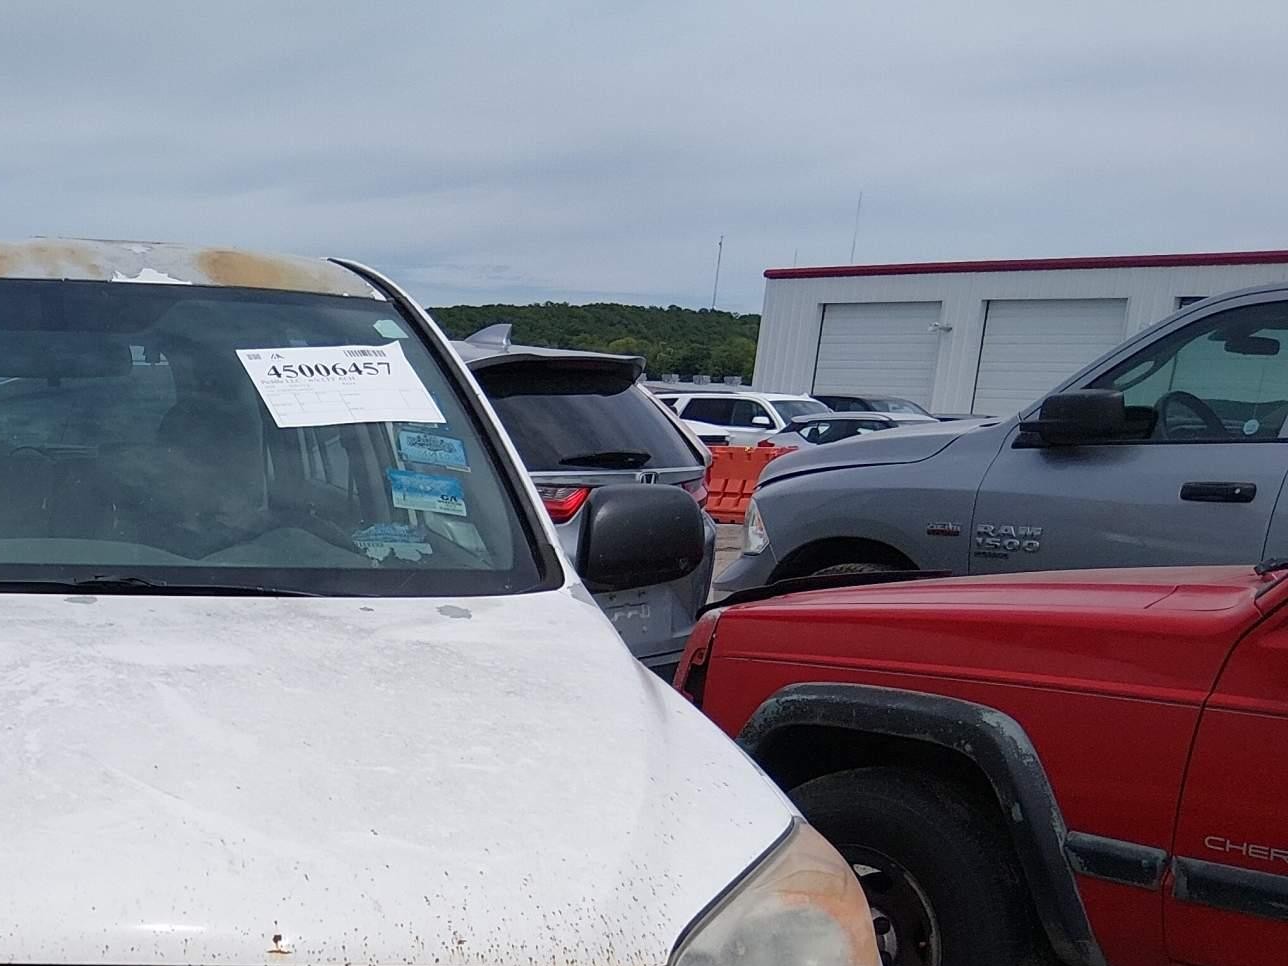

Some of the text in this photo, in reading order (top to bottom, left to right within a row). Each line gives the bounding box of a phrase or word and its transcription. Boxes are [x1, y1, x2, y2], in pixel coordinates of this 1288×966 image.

[267, 361, 391, 379] 45006457
[976, 523, 1043, 537] RAM
[1204, 835, 1288, 865] CHER
